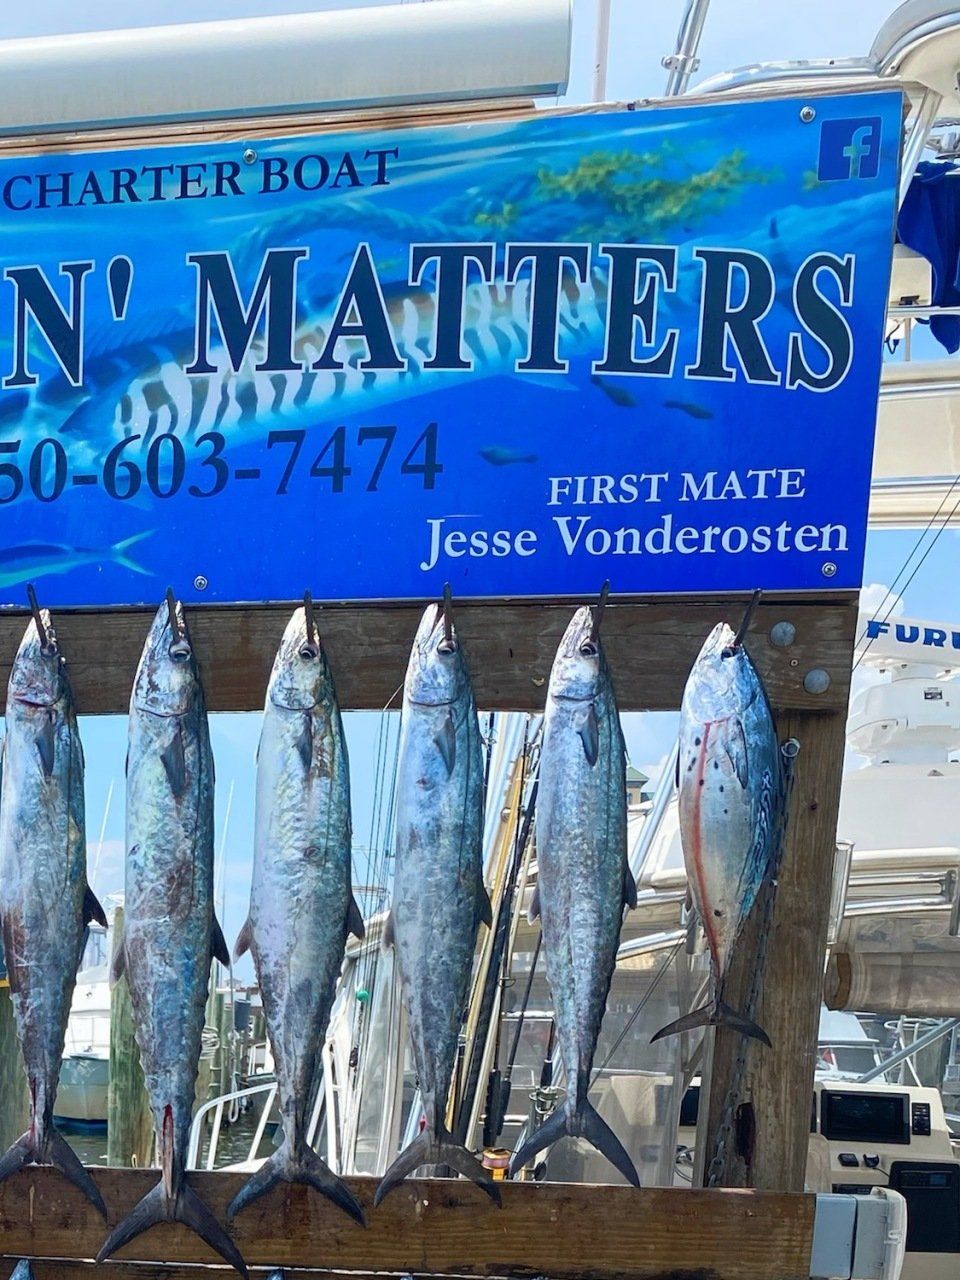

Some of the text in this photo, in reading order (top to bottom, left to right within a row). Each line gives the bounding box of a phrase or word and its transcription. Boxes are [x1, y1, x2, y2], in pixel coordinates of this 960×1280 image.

[2, 147, 399, 211] CHARTER BOAT
[185, 241, 856, 393] MATTERS
[546, 468, 807, 506] FIRST MATE
[419, 513, 849, 572] Jesse Vonderosten
